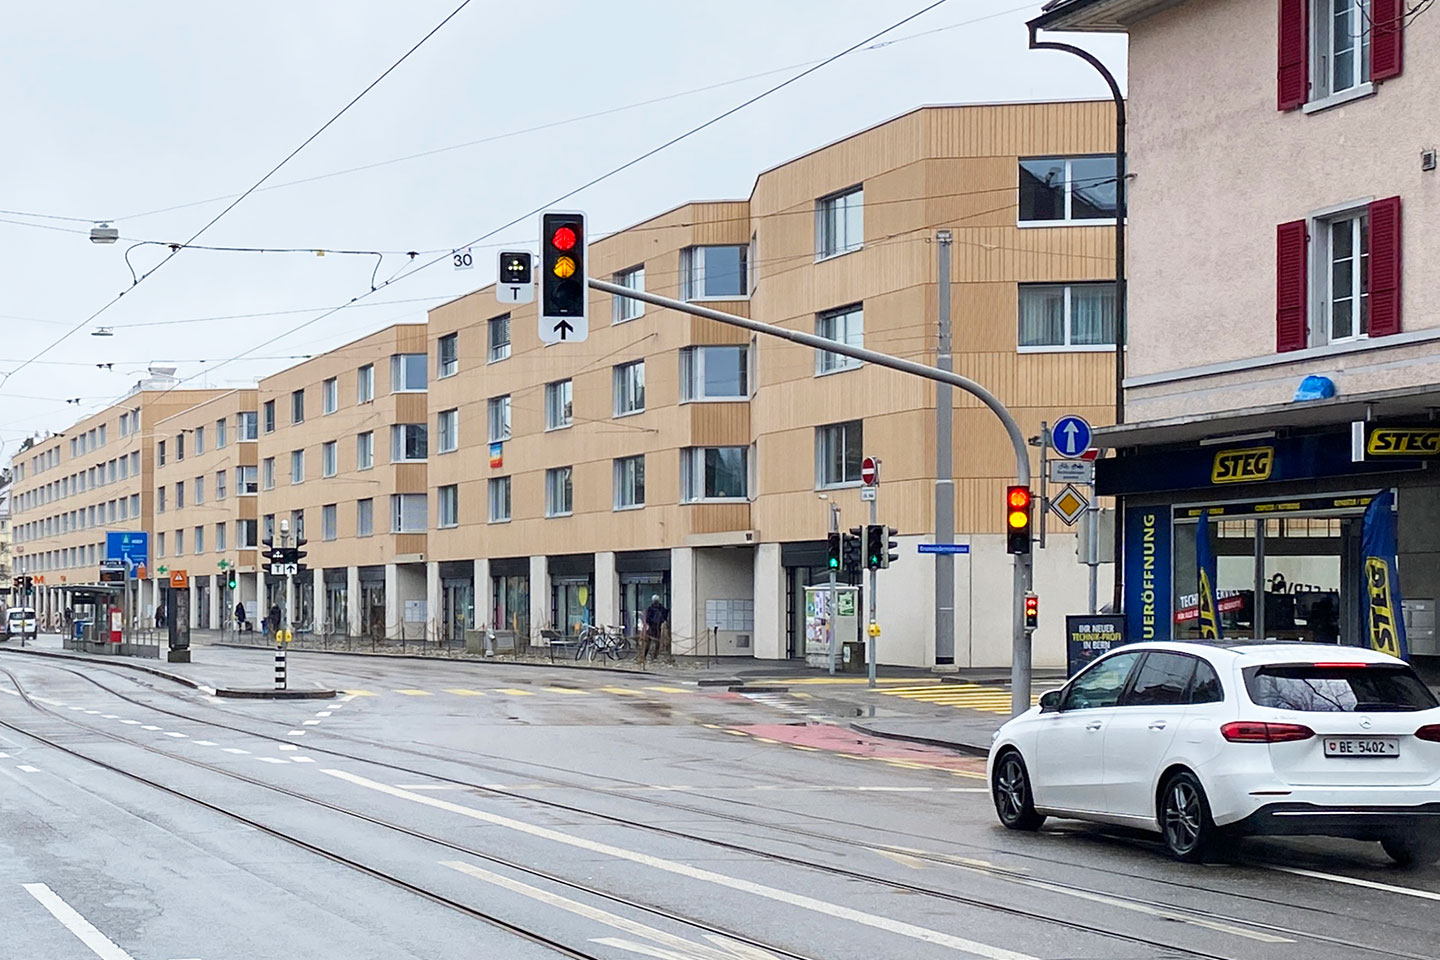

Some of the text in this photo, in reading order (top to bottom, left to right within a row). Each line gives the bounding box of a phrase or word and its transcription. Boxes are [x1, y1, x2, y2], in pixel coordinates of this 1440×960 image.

[453, 253, 473, 267] 30
[509, 286, 521, 301] T
[1373, 432, 1439, 451] STEG
[1215, 452, 1270, 478] STEG
[33, 575, 45, 585] M
[1141, 513, 1155, 639] UERÖFFNUNG
[1180, 593, 1199, 609] TECH
[1369, 564, 1394, 653] STEG
[1092, 624, 1114, 633] NEUER
[1339, 741, 1386, 753] BE 5402
